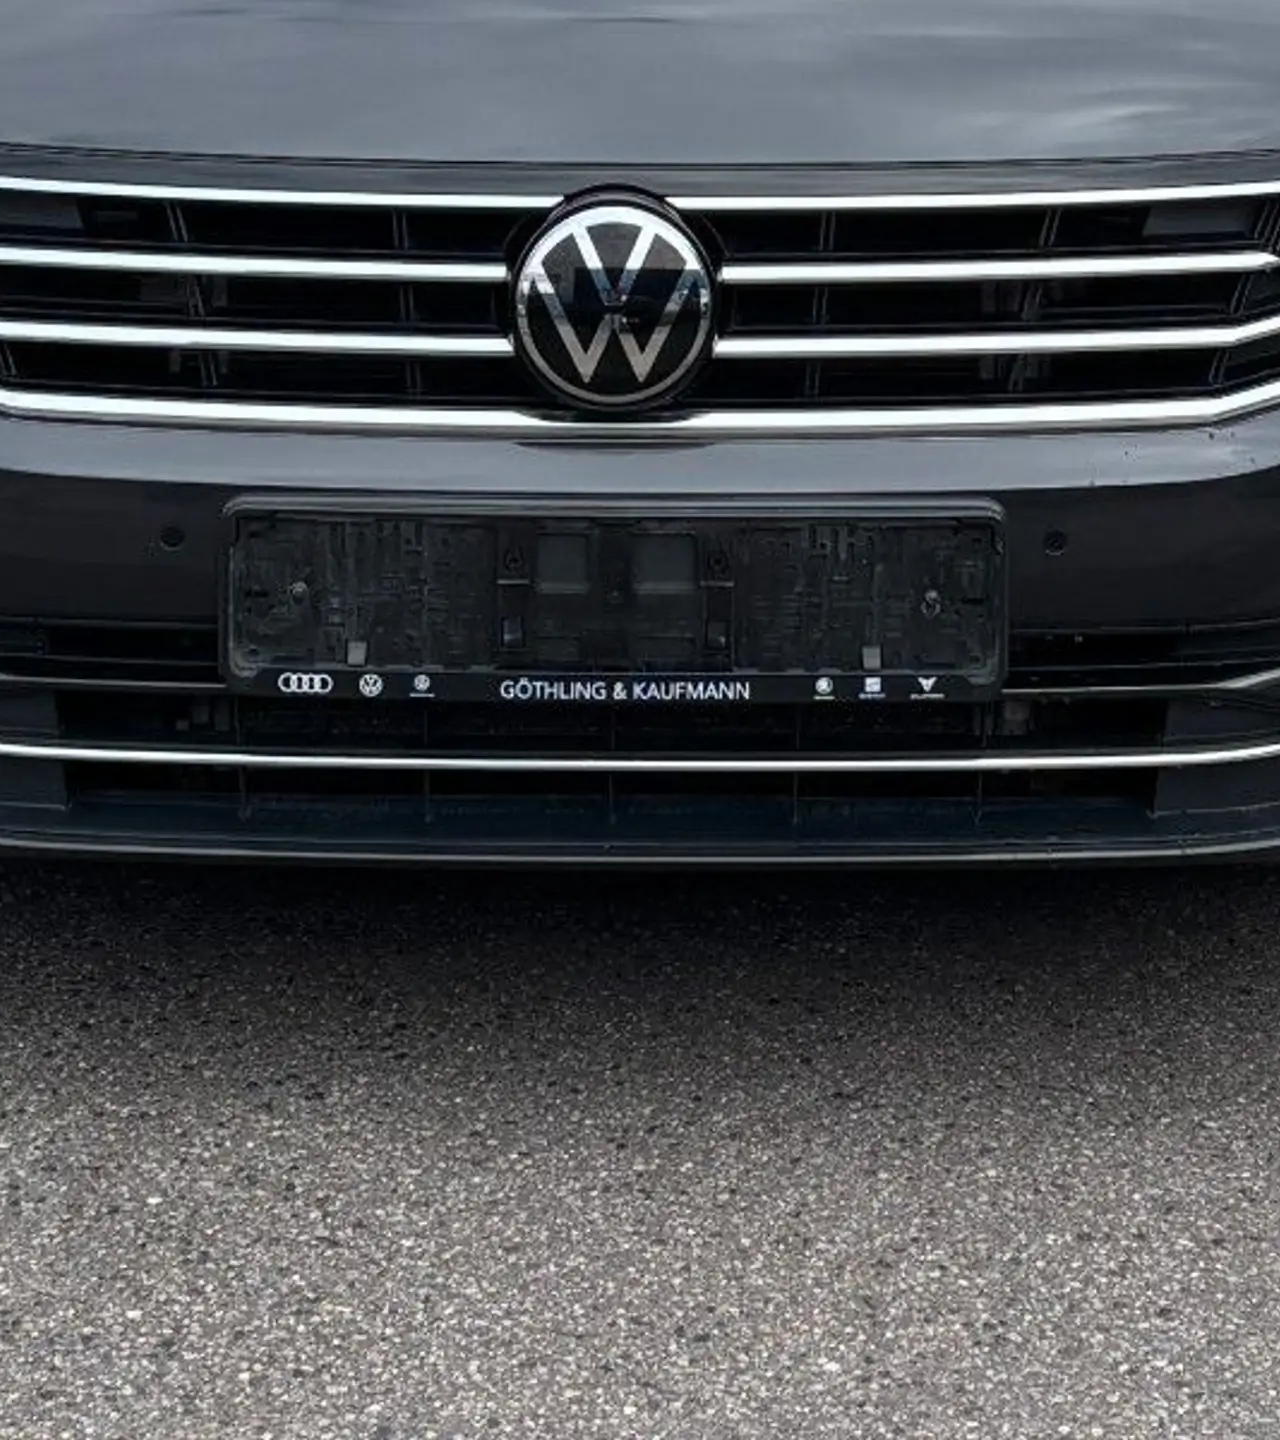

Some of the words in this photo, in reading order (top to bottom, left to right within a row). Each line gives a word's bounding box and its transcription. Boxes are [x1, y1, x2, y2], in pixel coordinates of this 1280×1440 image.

[500, 677, 607, 700] GÖTHLING
[613, 681, 628, 700] &
[633, 681, 750, 701] KAUFMANN
